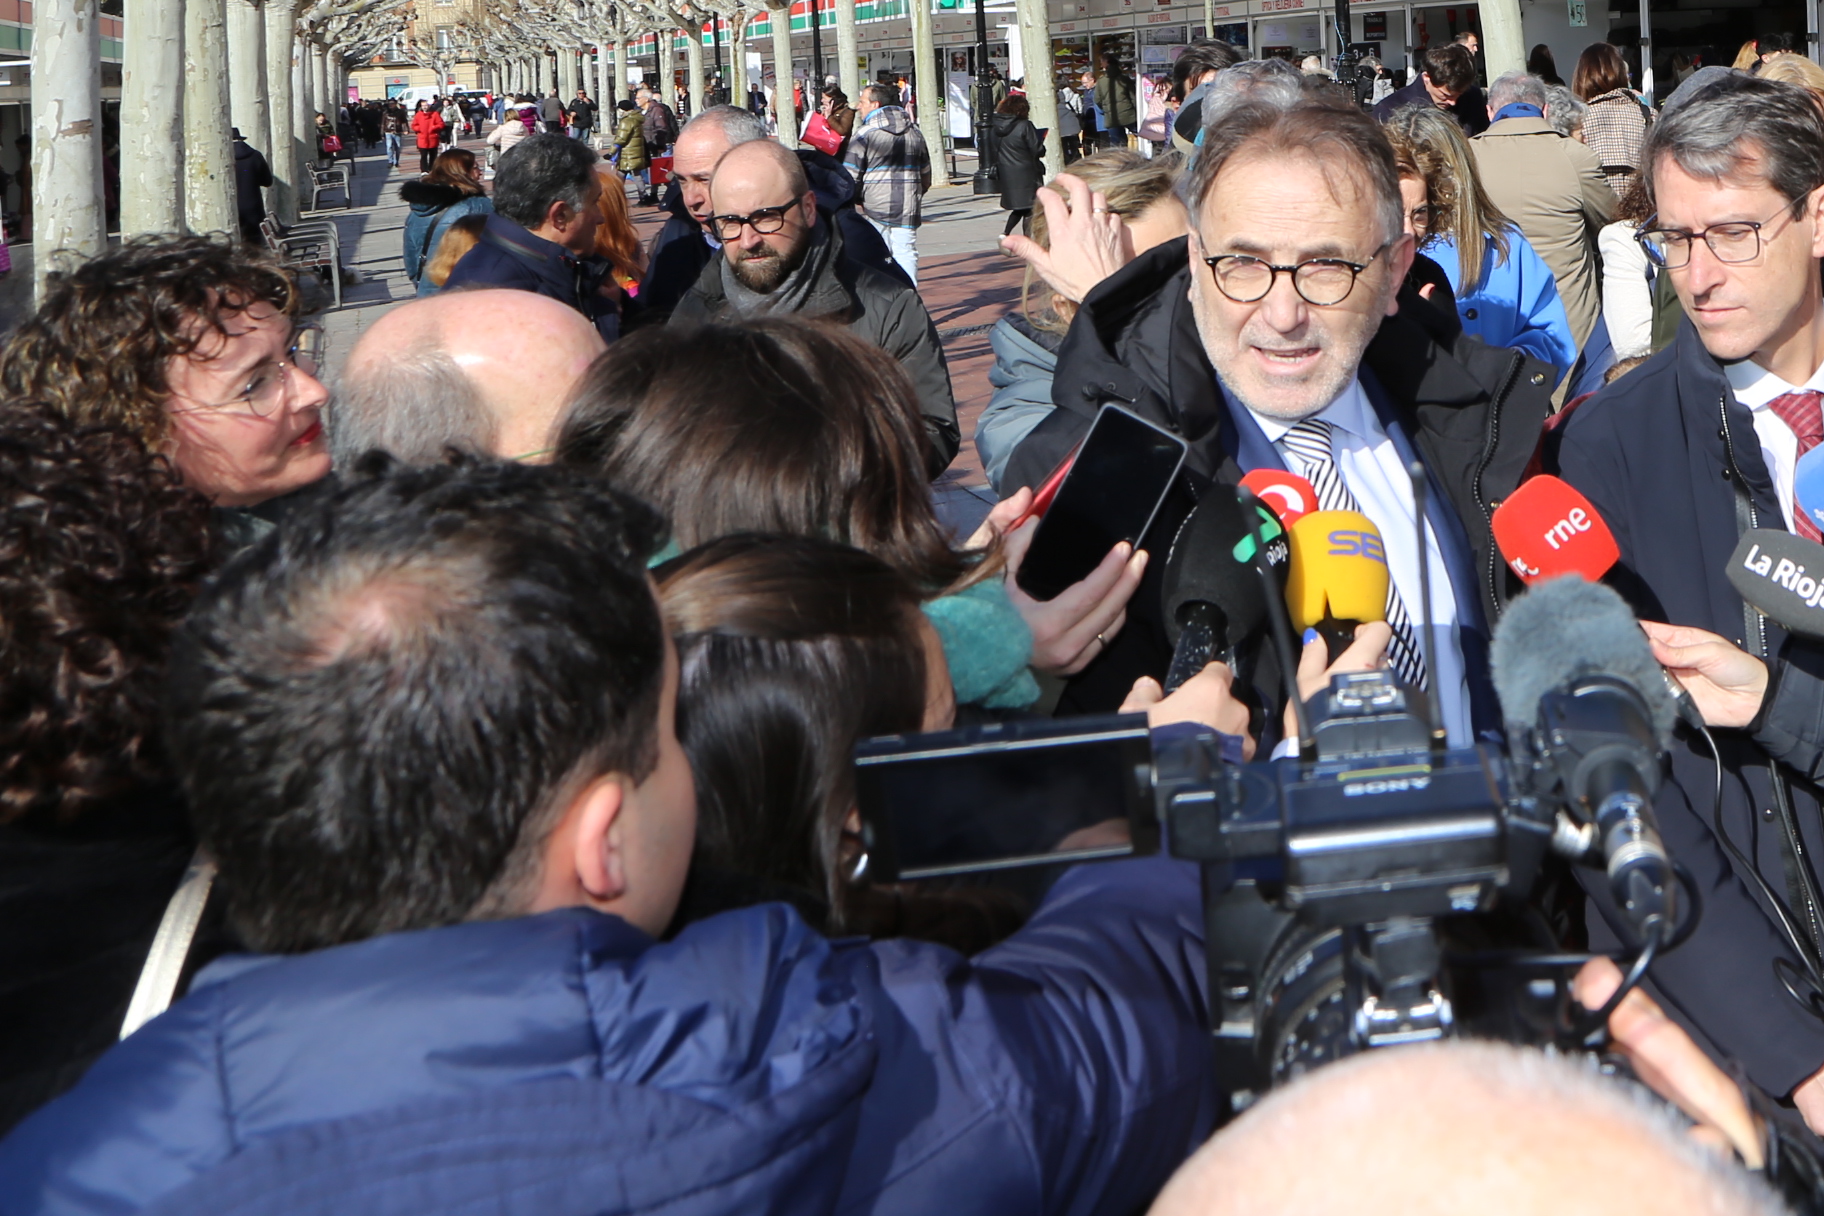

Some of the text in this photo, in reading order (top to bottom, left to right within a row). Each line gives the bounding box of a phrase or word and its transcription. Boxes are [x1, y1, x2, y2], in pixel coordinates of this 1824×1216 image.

[1543, 507, 1592, 550] rne
[1265, 540, 1288, 567] Rioja
[1743, 544, 1773, 577] La
